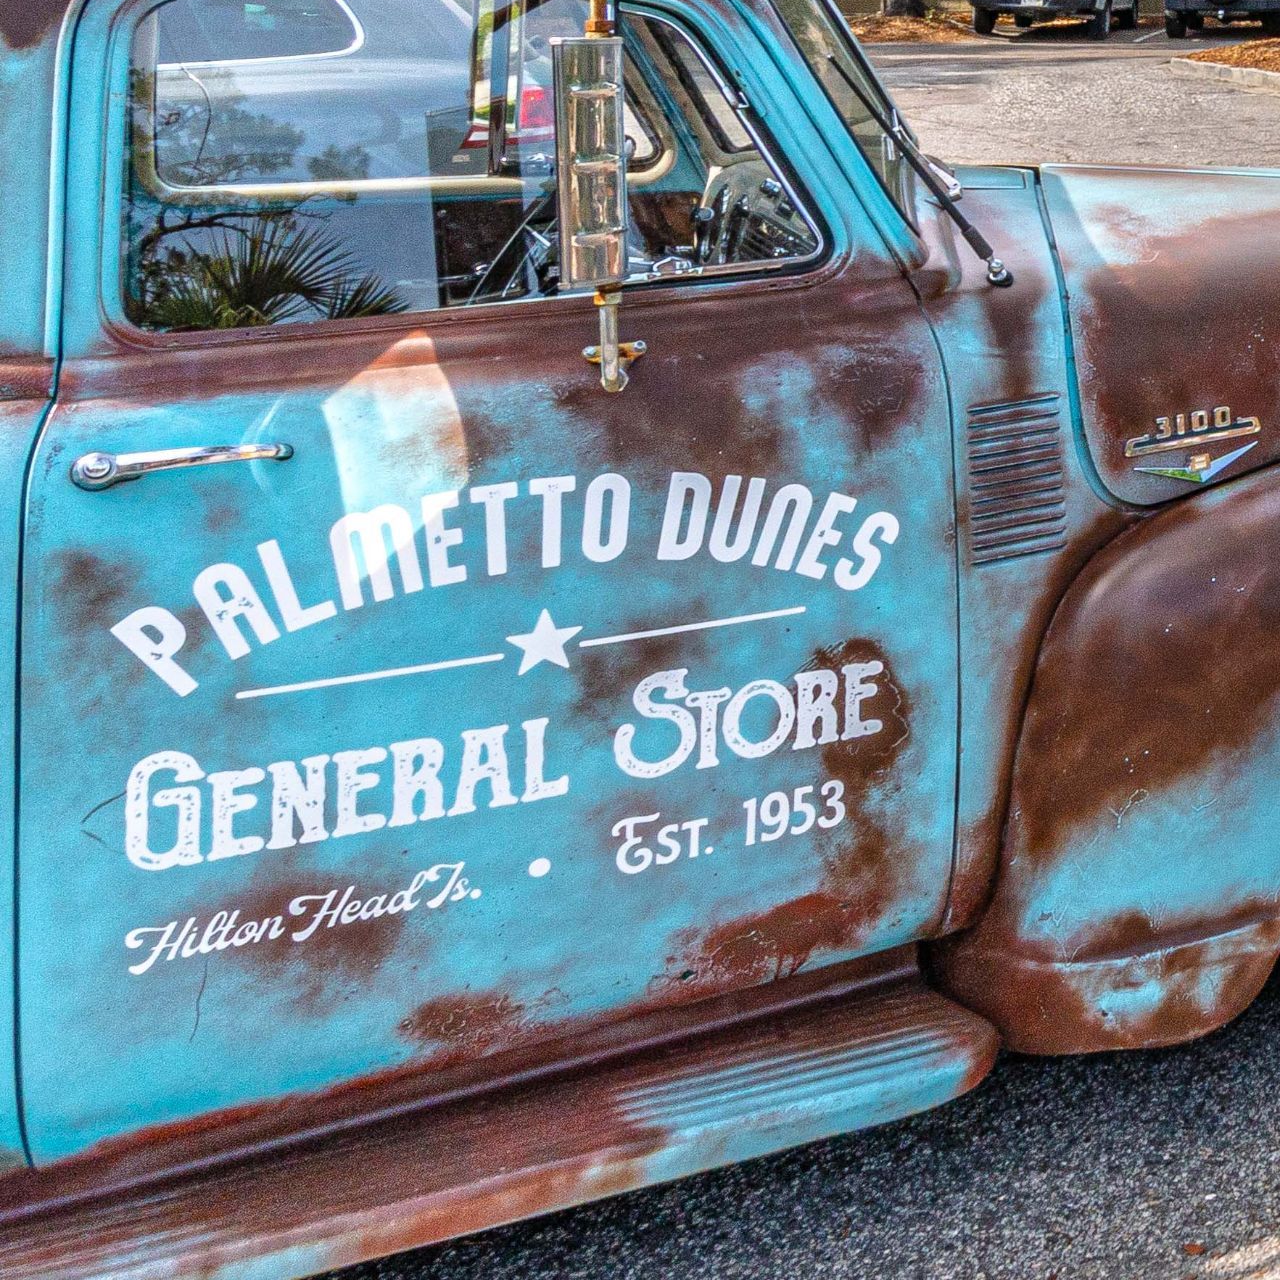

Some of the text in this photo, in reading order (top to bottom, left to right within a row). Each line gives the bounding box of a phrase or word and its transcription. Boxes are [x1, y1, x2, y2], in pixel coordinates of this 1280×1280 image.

[1155, 405, 1232, 440] 3100
[111, 472, 901, 697] PALMETTO DUNES
[124, 661, 884, 872] GENERAL STORE
[742, 779, 846, 847] 1953
[125, 861, 483, 975] Hilton Head Is.
